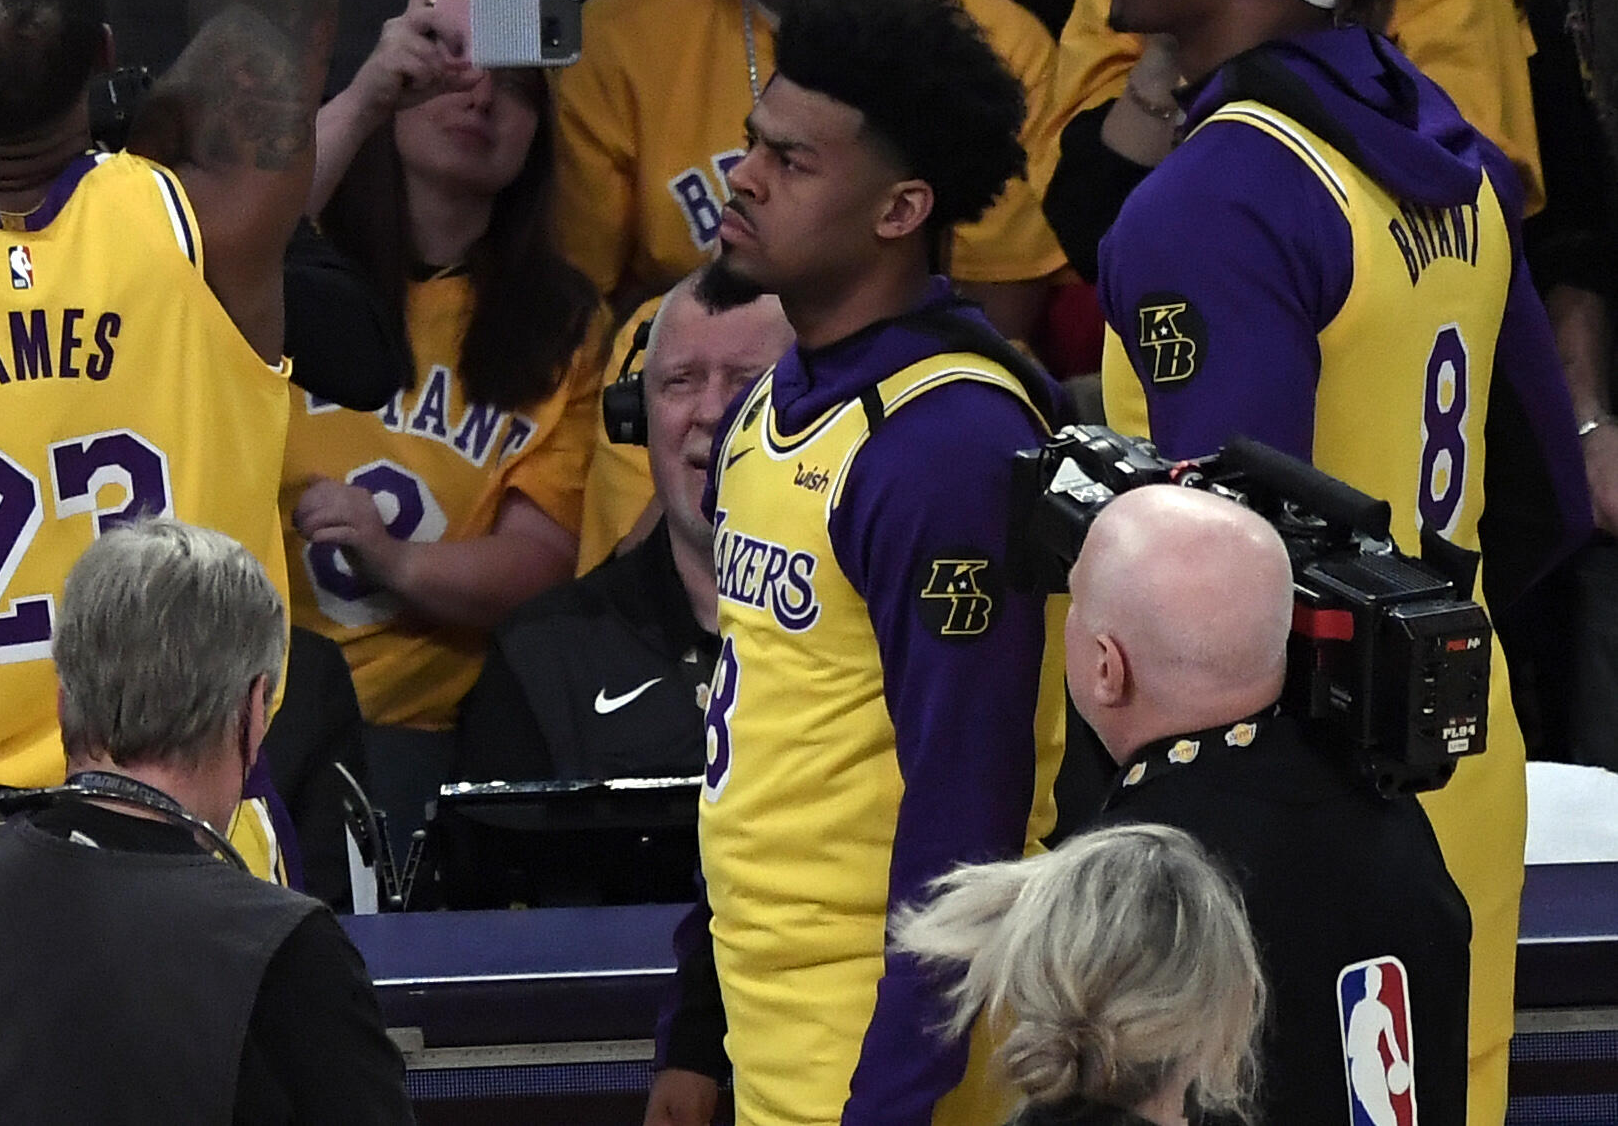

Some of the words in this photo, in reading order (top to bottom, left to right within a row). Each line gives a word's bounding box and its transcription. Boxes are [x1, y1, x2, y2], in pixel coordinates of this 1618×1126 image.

[794, 461, 830, 494] wish
[1415, 321, 1469, 542] 8
[703, 633, 741, 804] 8
